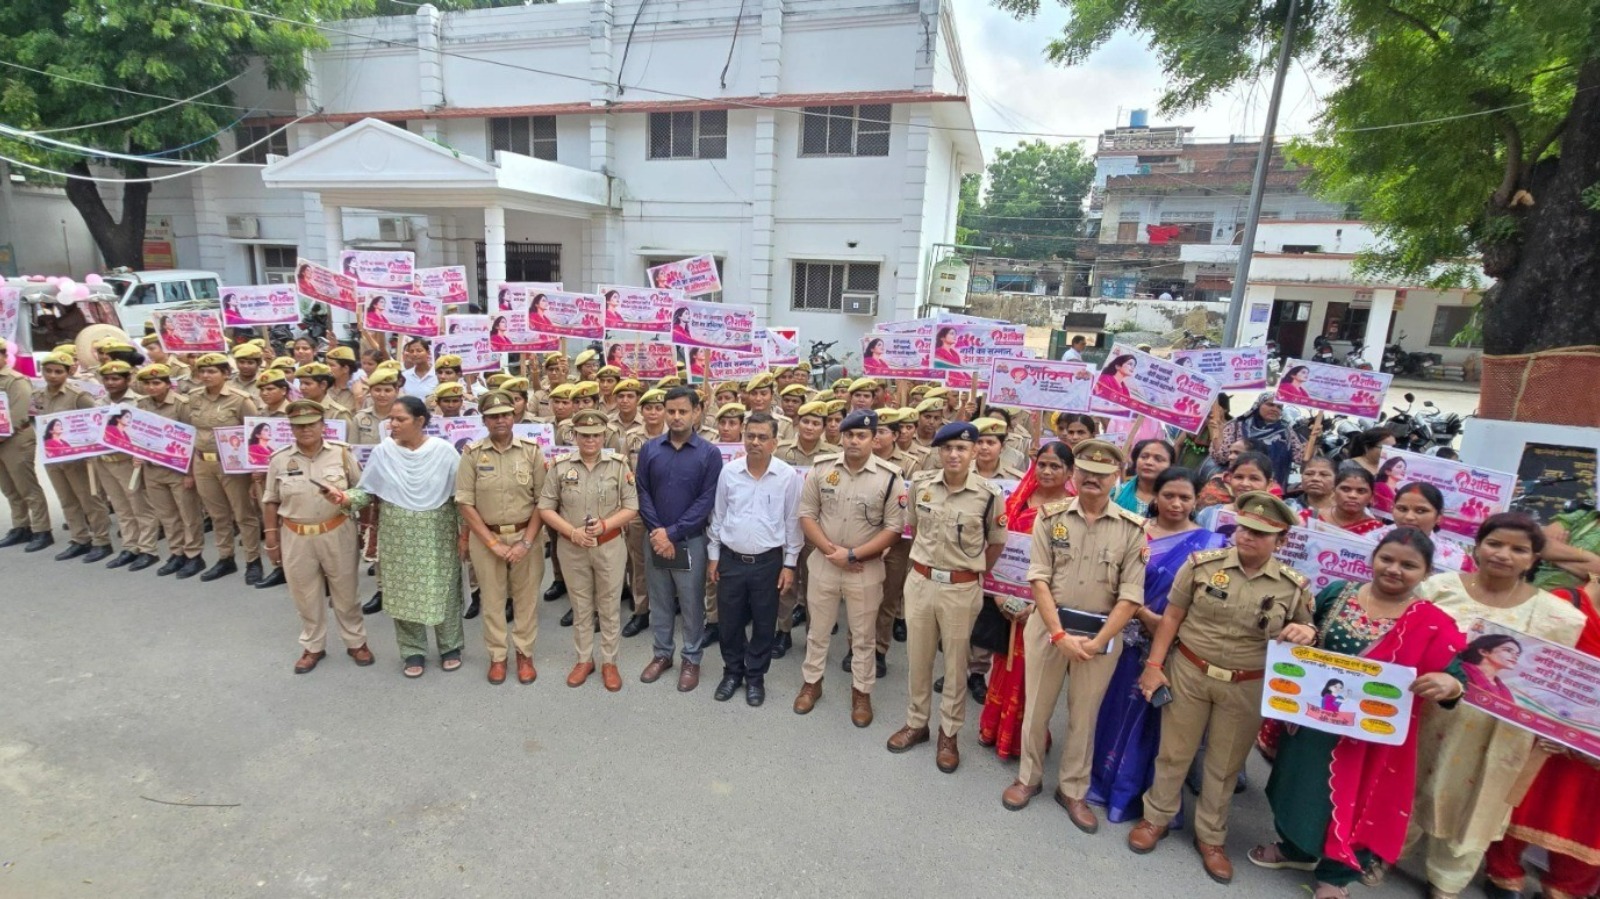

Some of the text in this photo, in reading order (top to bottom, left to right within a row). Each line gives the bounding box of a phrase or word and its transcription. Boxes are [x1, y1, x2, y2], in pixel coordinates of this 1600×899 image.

[1471, 478, 1502, 495] शक्ति
[1340, 548, 1366, 560] मिशन
[1542, 647, 1570, 662] महिला
[1534, 655, 1567, 671] महिला
[1519, 672, 1546, 685] भारत
